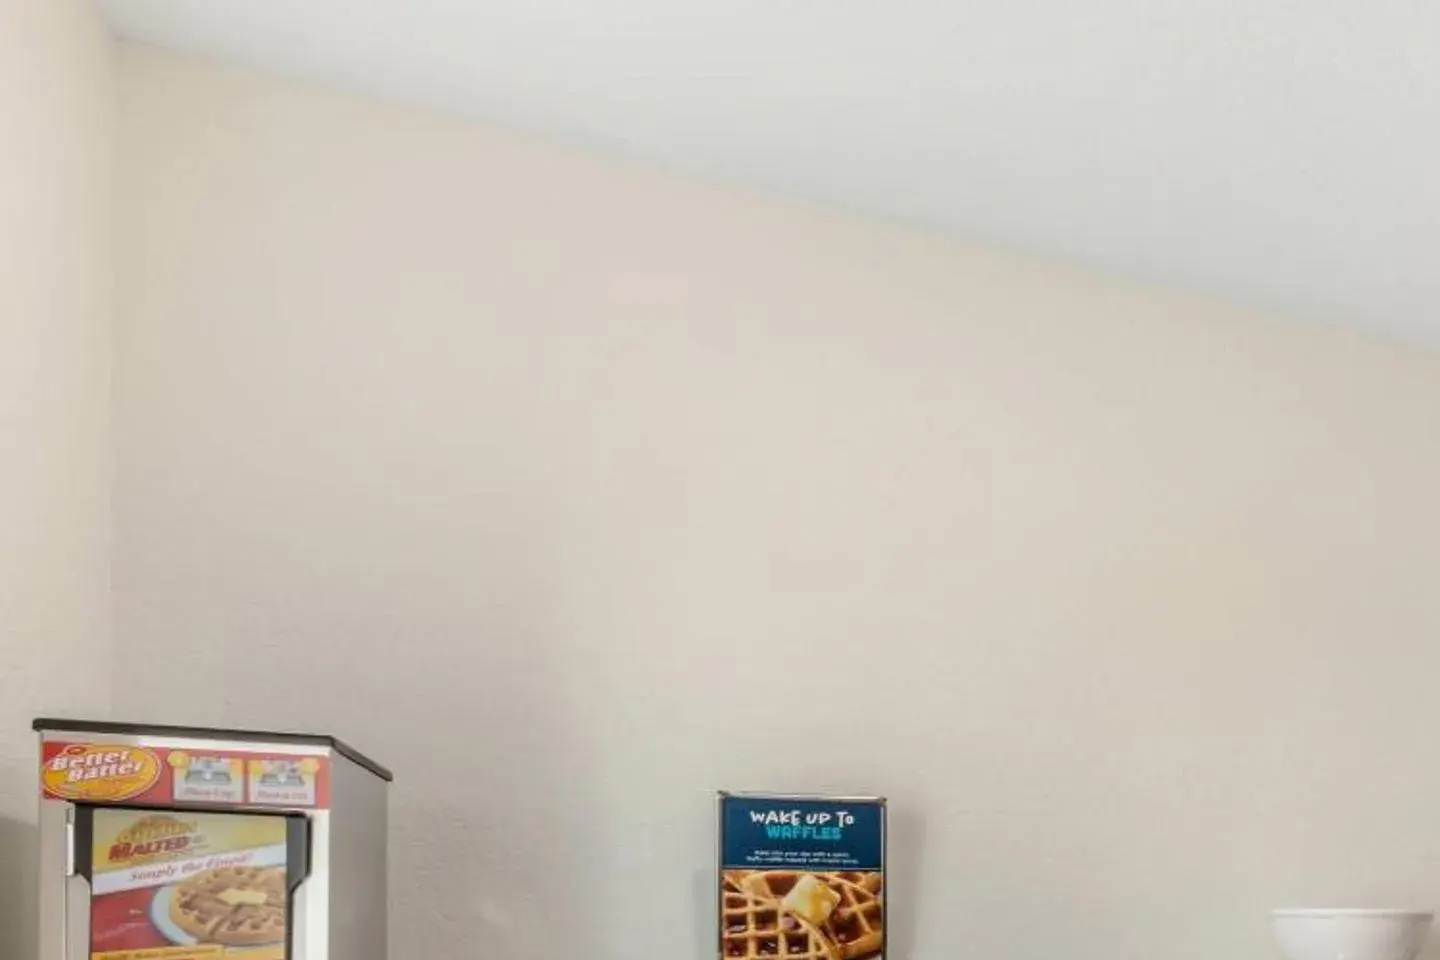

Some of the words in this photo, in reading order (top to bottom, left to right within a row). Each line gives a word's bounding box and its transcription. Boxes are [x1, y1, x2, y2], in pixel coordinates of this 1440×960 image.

[750, 809, 802, 826] WAKE
[805, 811, 832, 824] UP
[766, 825, 842, 840] WAFFLES
[108, 836, 190, 863] MALTED
